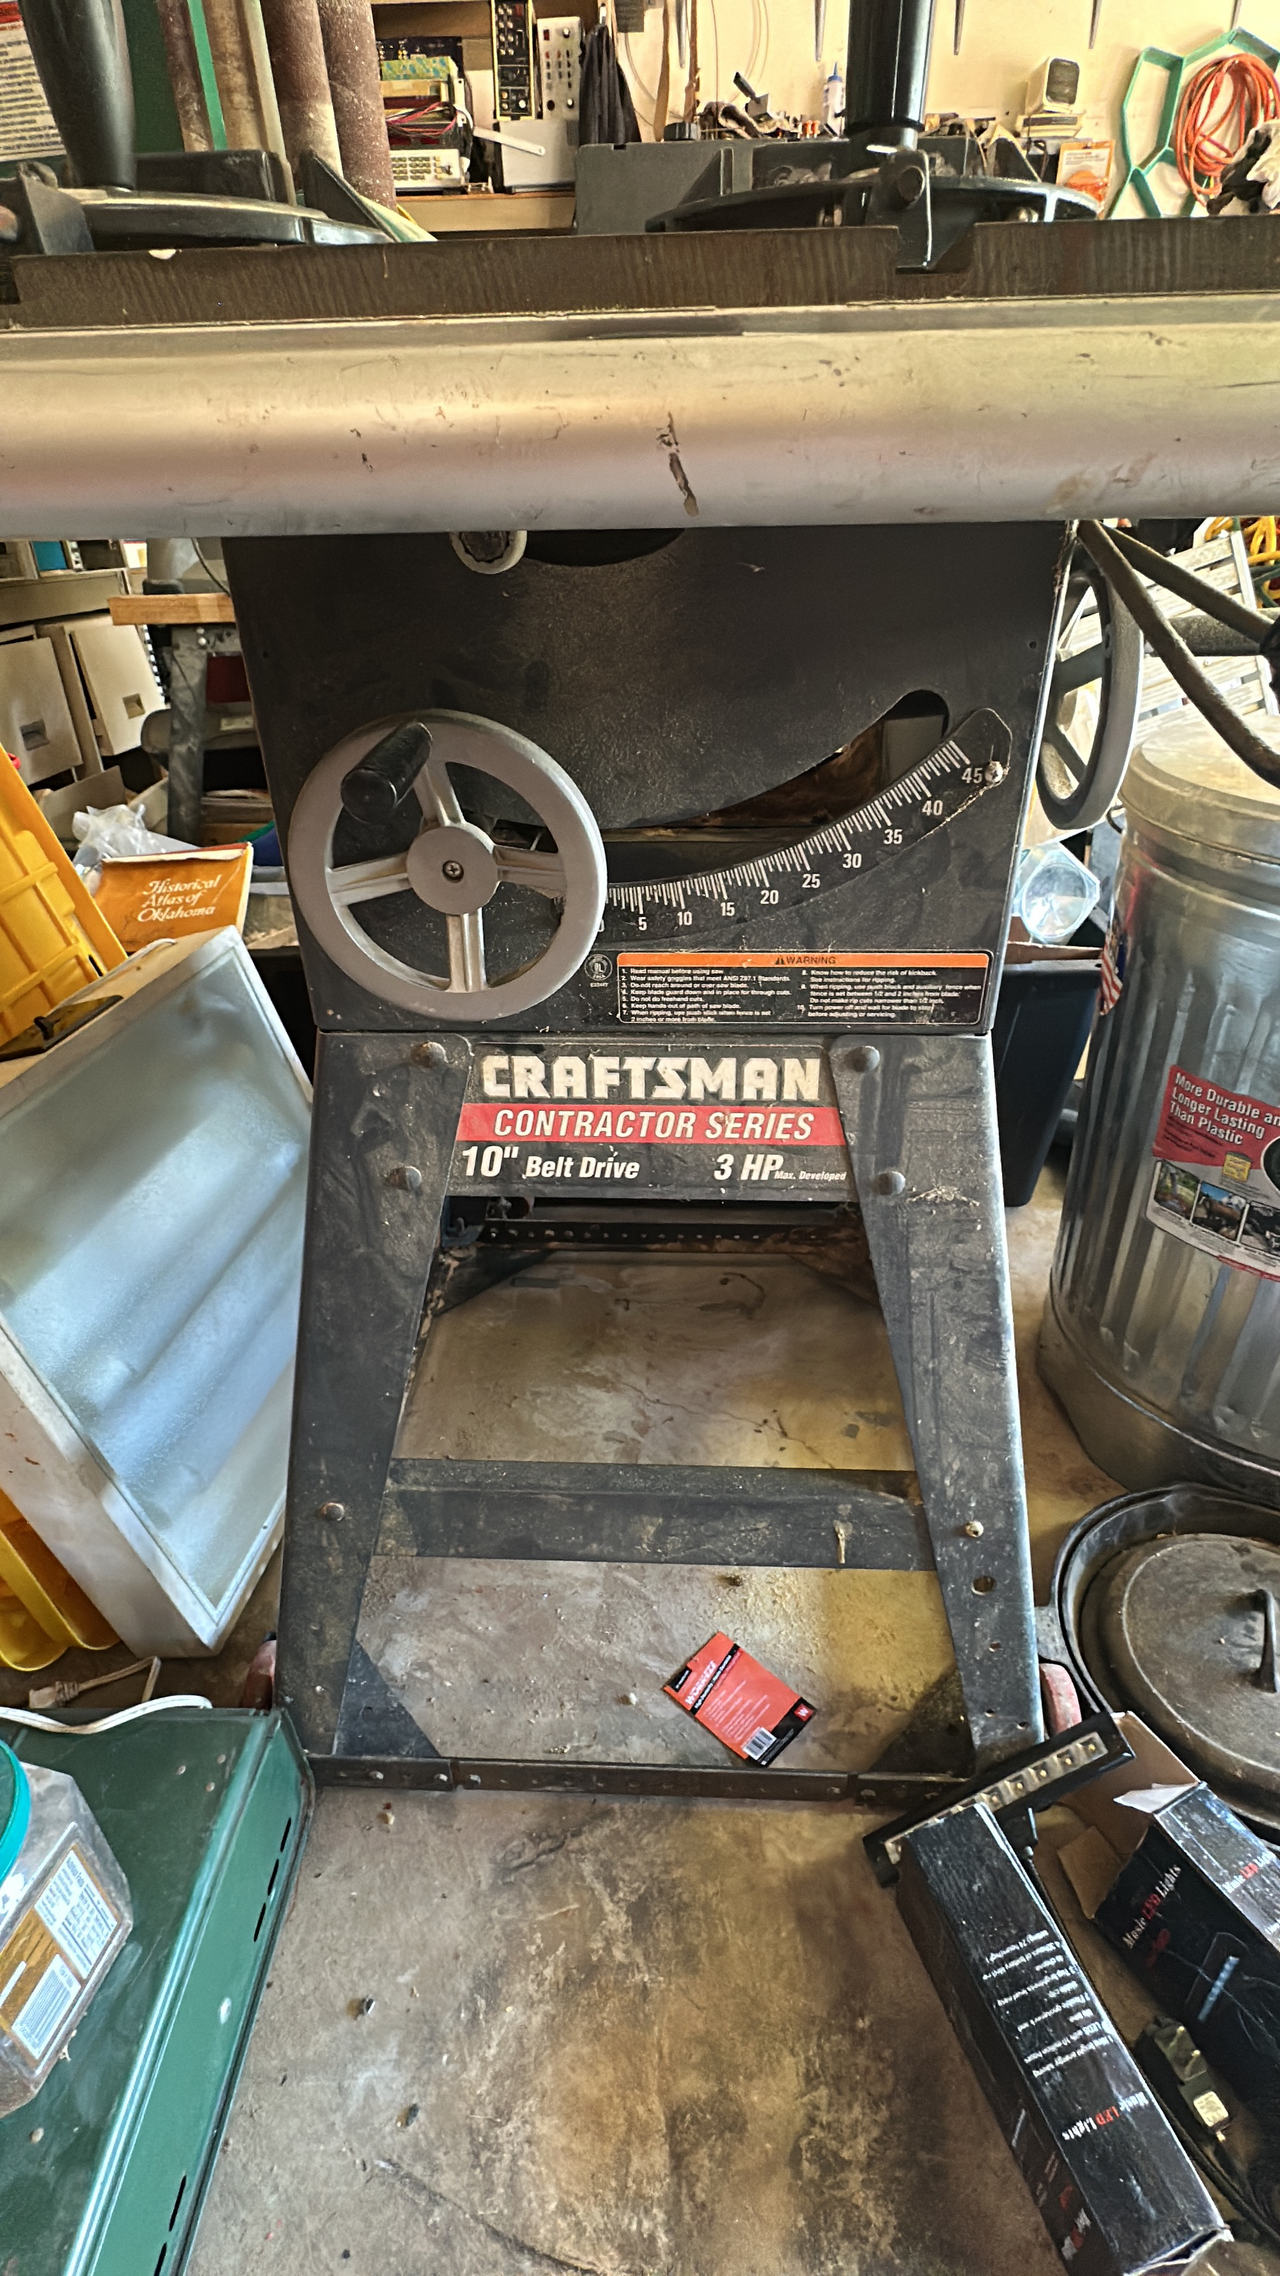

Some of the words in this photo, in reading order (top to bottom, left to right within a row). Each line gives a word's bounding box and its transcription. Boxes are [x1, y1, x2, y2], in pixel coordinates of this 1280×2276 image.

[638, 917, 647, 931] 5
[677, 911, 693, 926] 10
[720, 903, 735, 916] 15
[760, 890, 779, 905] 20
[802, 874, 820, 889] 25
[842, 853, 862, 868] 30
[883, 829, 903, 844] 35
[921, 800, 943, 816] 40
[961, 767, 983, 783] 45
[141, 893, 183, 908] Atlas
[185, 889, 207, 906] of
[142, 873, 222, 895] Historical
[137, 906, 216, 922] Oklahoma
[786, 956, 837, 965] WARNING
[483, 1054, 821, 1101] CRAFTSMAN
[1175, 1072, 1203, 1097] More
[1206, 1088, 1260, 1119] Durable
[494, 1109, 695, 1139] CONTRACTOR
[705, 1112, 815, 1141] SERIES
[1170, 1101, 1194, 1125] Than
[1198, 1117, 1243, 1144] Plastic
[1172, 1087, 1212, 1115] Longer
[1214, 1108, 1265, 1139] Lasting
[461, 1145, 519, 1178] 10"
[525, 1155, 573, 1179] Belt
[578, 1156, 640, 1179] Drive
[714, 1153, 732, 1181] 3
[741, 1154, 784, 1181] HP
[774, 1170, 796, 1180] Max.
[799, 1170, 847, 1181] Developed
[1123, 1917, 1146, 1948] Music
[1142, 1894, 1161, 1919] LED
[1155, 1867, 1181, 1898] Lights
[1096, 2106, 1119, 2125] LED
[1118, 2092, 1149, 2112] Music
[1062, 2117, 1097, 2140] Lights
